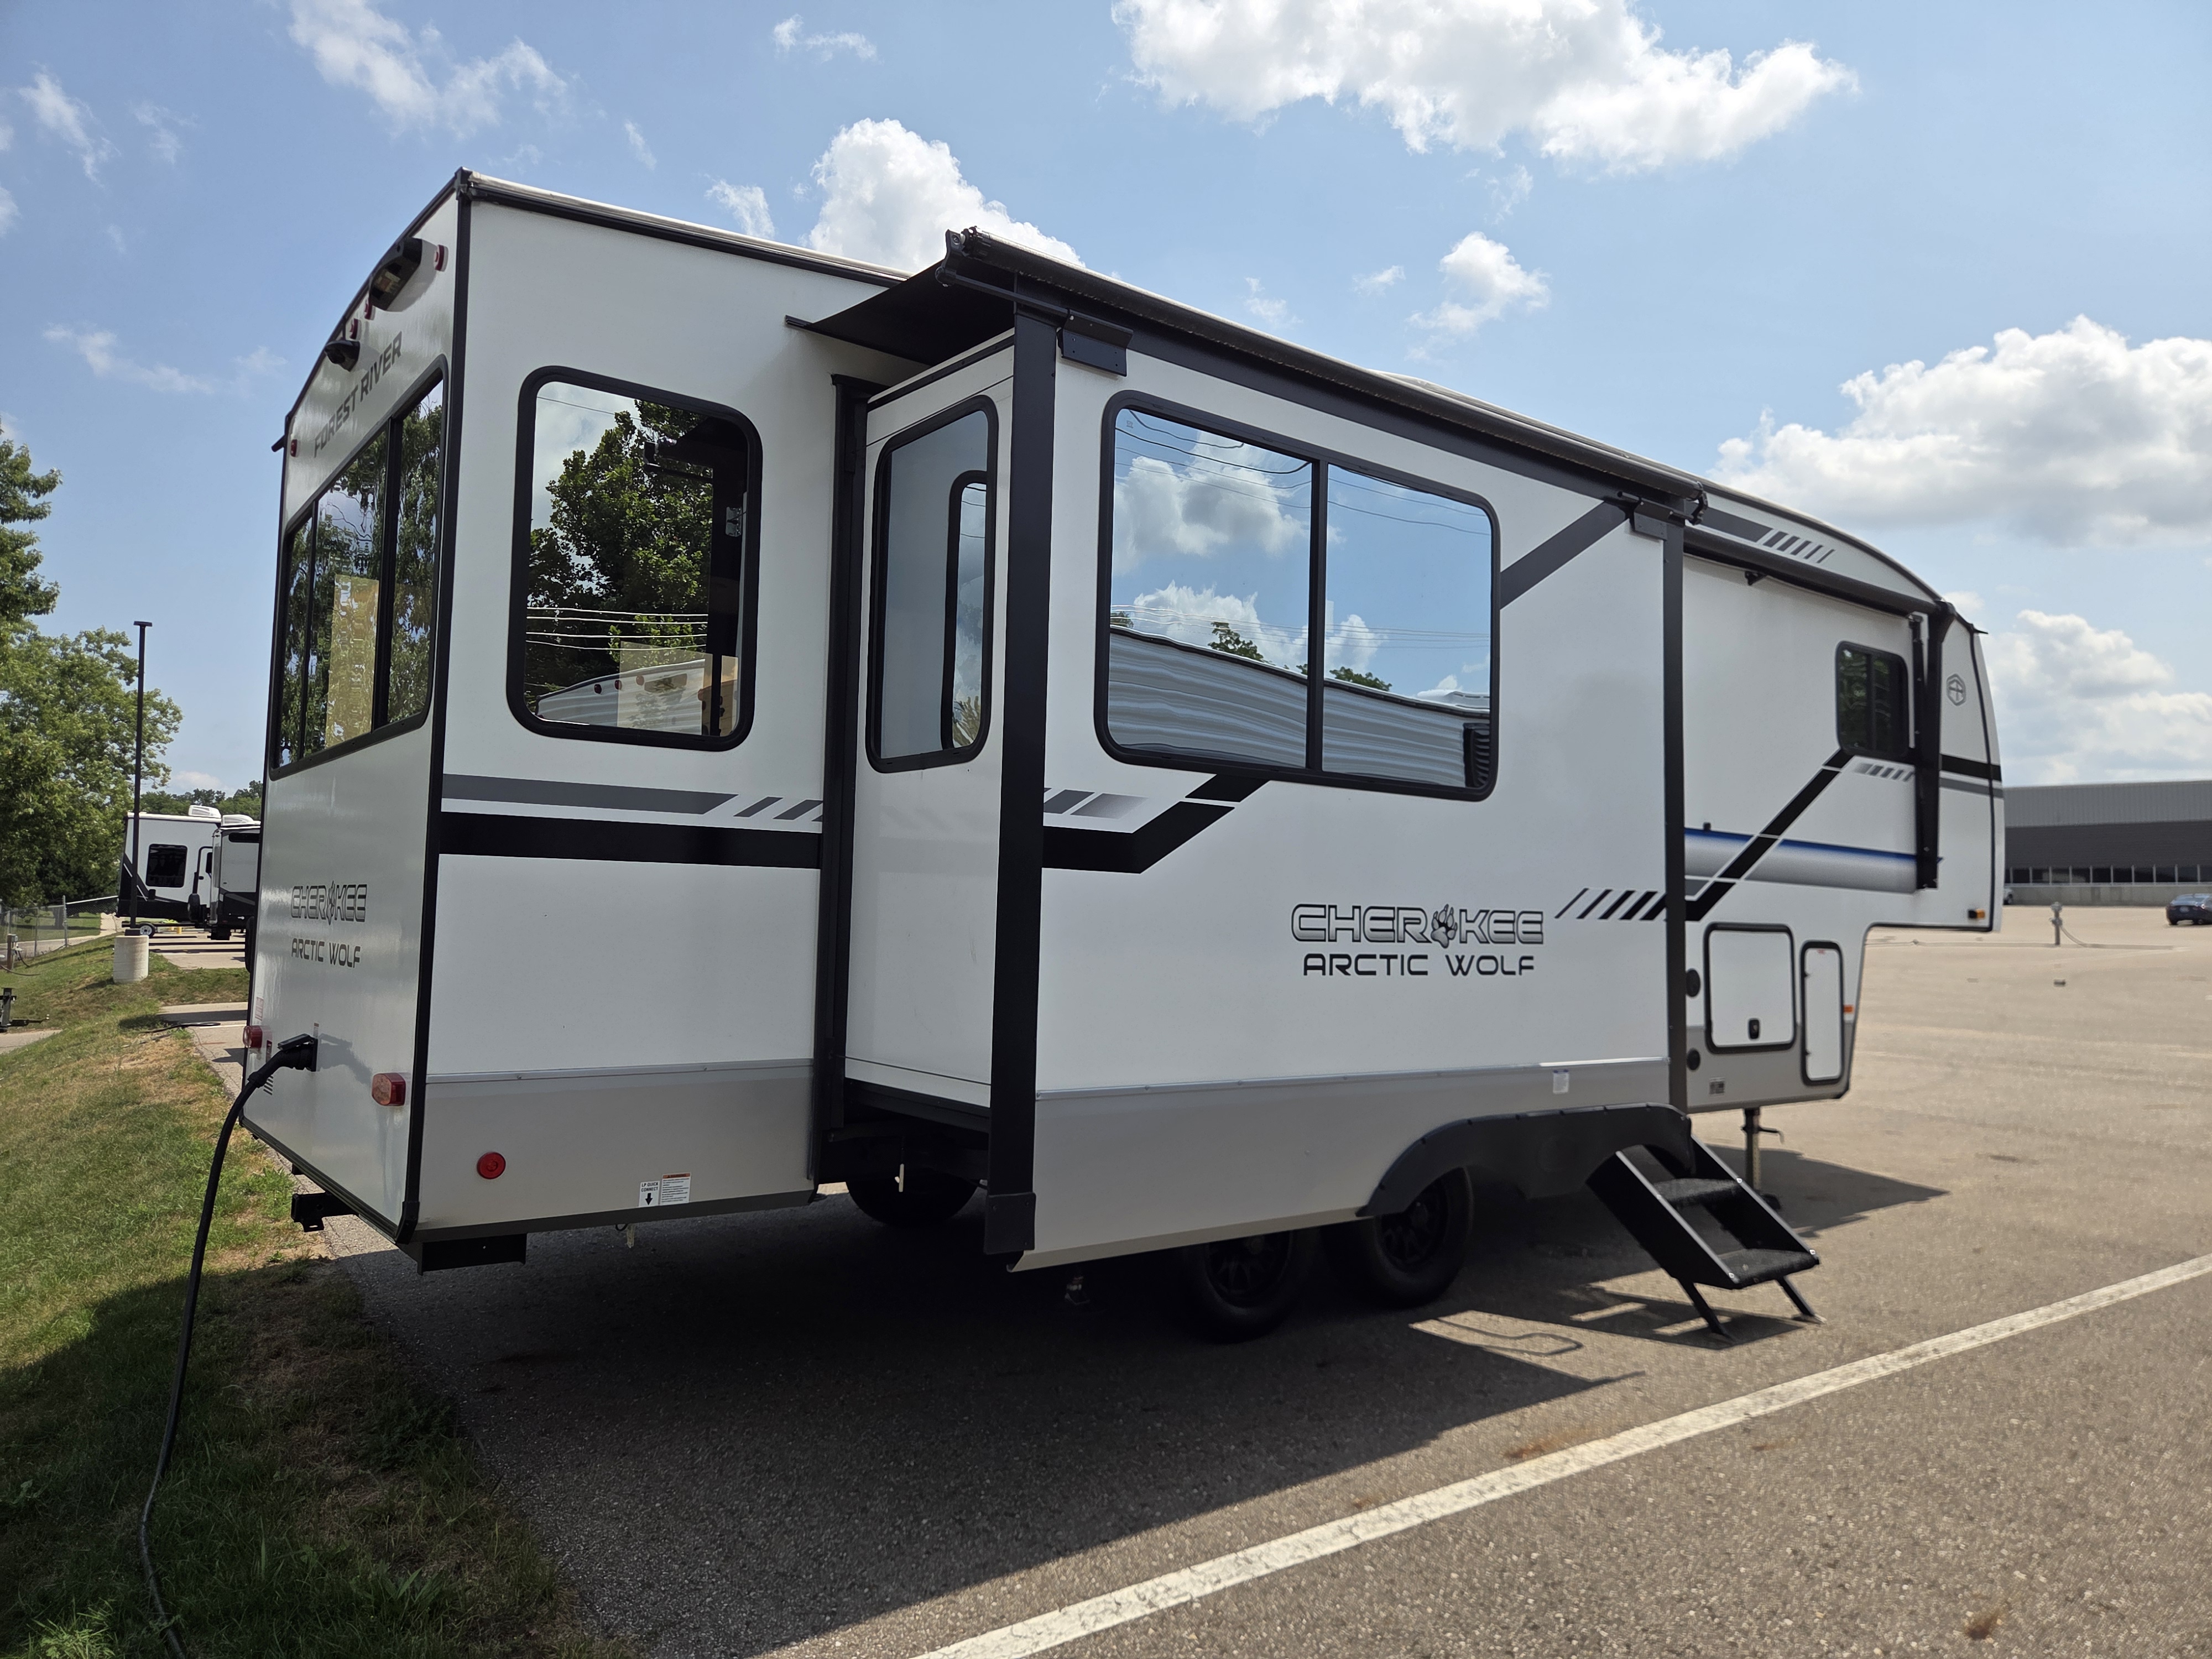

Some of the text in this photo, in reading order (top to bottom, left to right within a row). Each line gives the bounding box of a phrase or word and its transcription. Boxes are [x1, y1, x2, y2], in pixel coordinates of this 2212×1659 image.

[314, 331, 403, 458] FOREST RIVER
[291, 938, 361, 968] ARCTIC WOLF
[1303, 953, 1535, 977] ARCTIC WOLF
